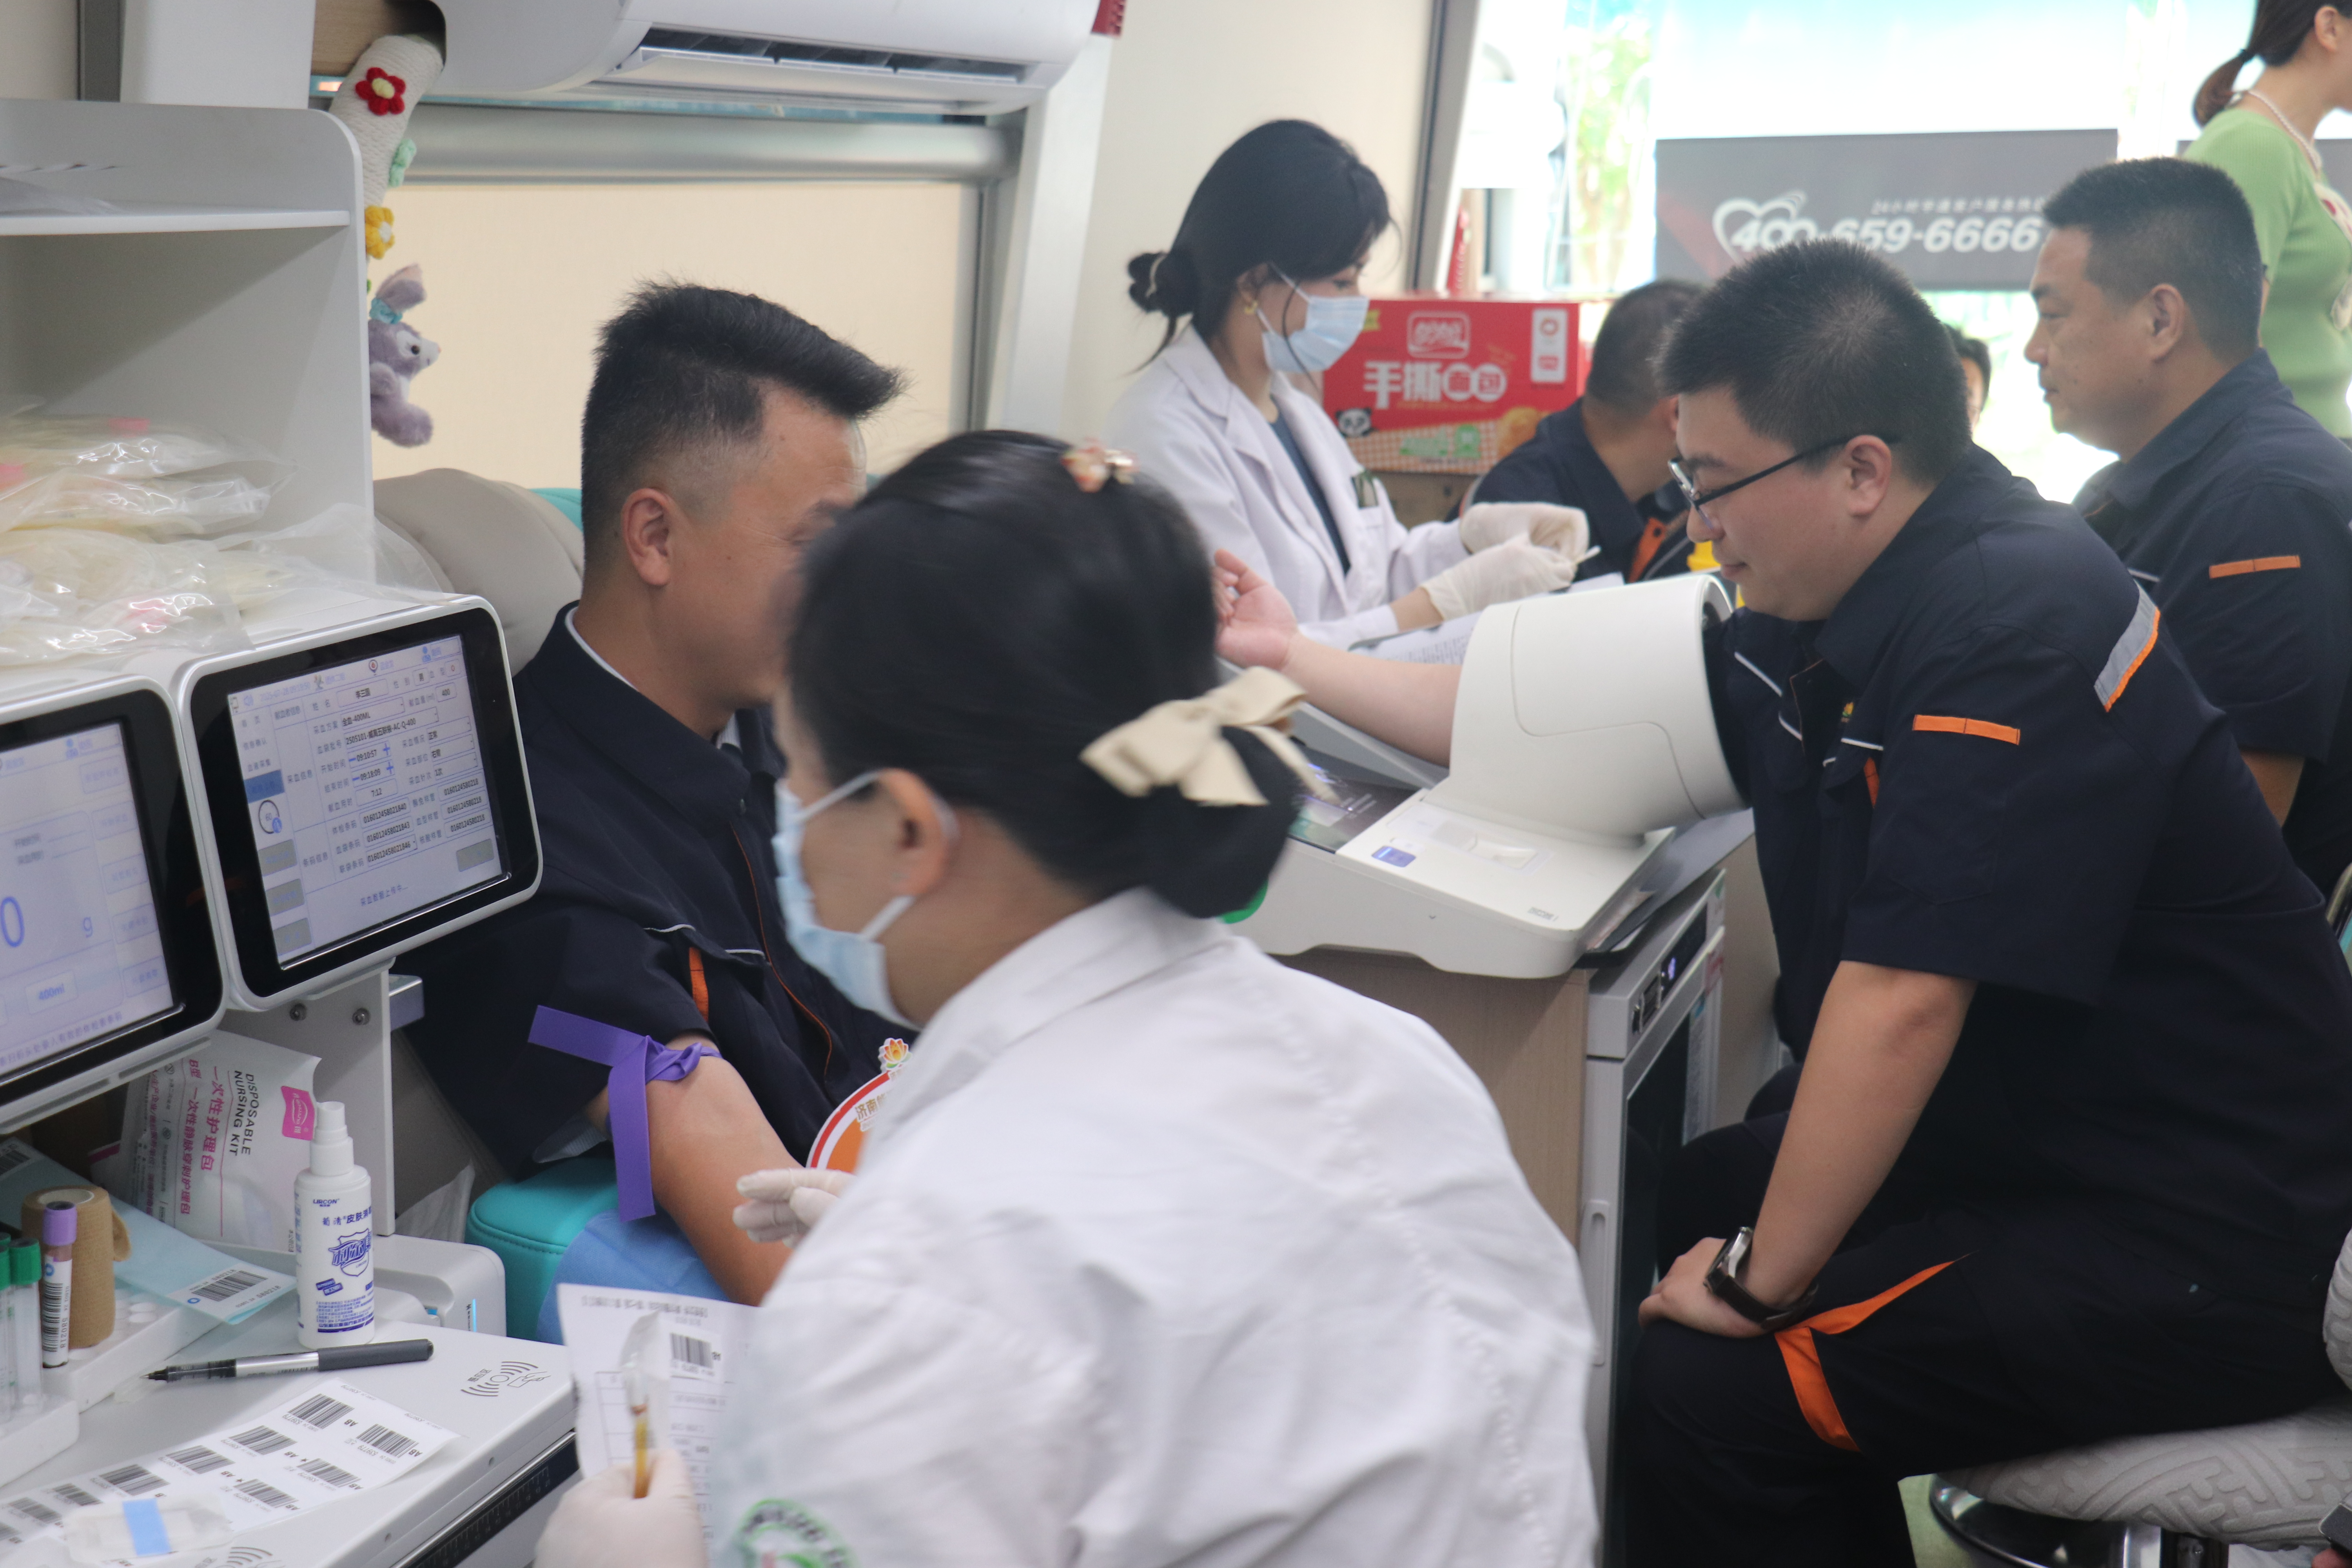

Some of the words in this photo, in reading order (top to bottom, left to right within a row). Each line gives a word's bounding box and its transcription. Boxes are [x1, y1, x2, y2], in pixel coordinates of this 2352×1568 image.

[441, 688, 450, 697] 400
[357, 750, 377, 762] 09:10:57
[321, 759, 345, 773] 开始时间
[361, 769, 380, 780] 09:18:09
[325, 779, 349, 793] 结束时间
[372, 788, 381, 797] 7:12
[83, 916, 93, 938] g
[38, 983, 65, 1000] 400ml
[189, 1059, 201, 1078] B型
[233, 1070, 247, 1129] NURSING
[201, 1066, 225, 1171] 一次性护理包
[241, 1073, 259, 1155] DISPOSABLE
[180, 1088, 200, 1214] 一次性静脉穿刺护理包
[229, 1134, 241, 1156] KIT
[256, 1285, 281, 1299] 580218
[60, 1317, 68, 1348] 580218
[357, 1445, 379, 1457] 539779
[408, 1449, 423, 1457] AB
